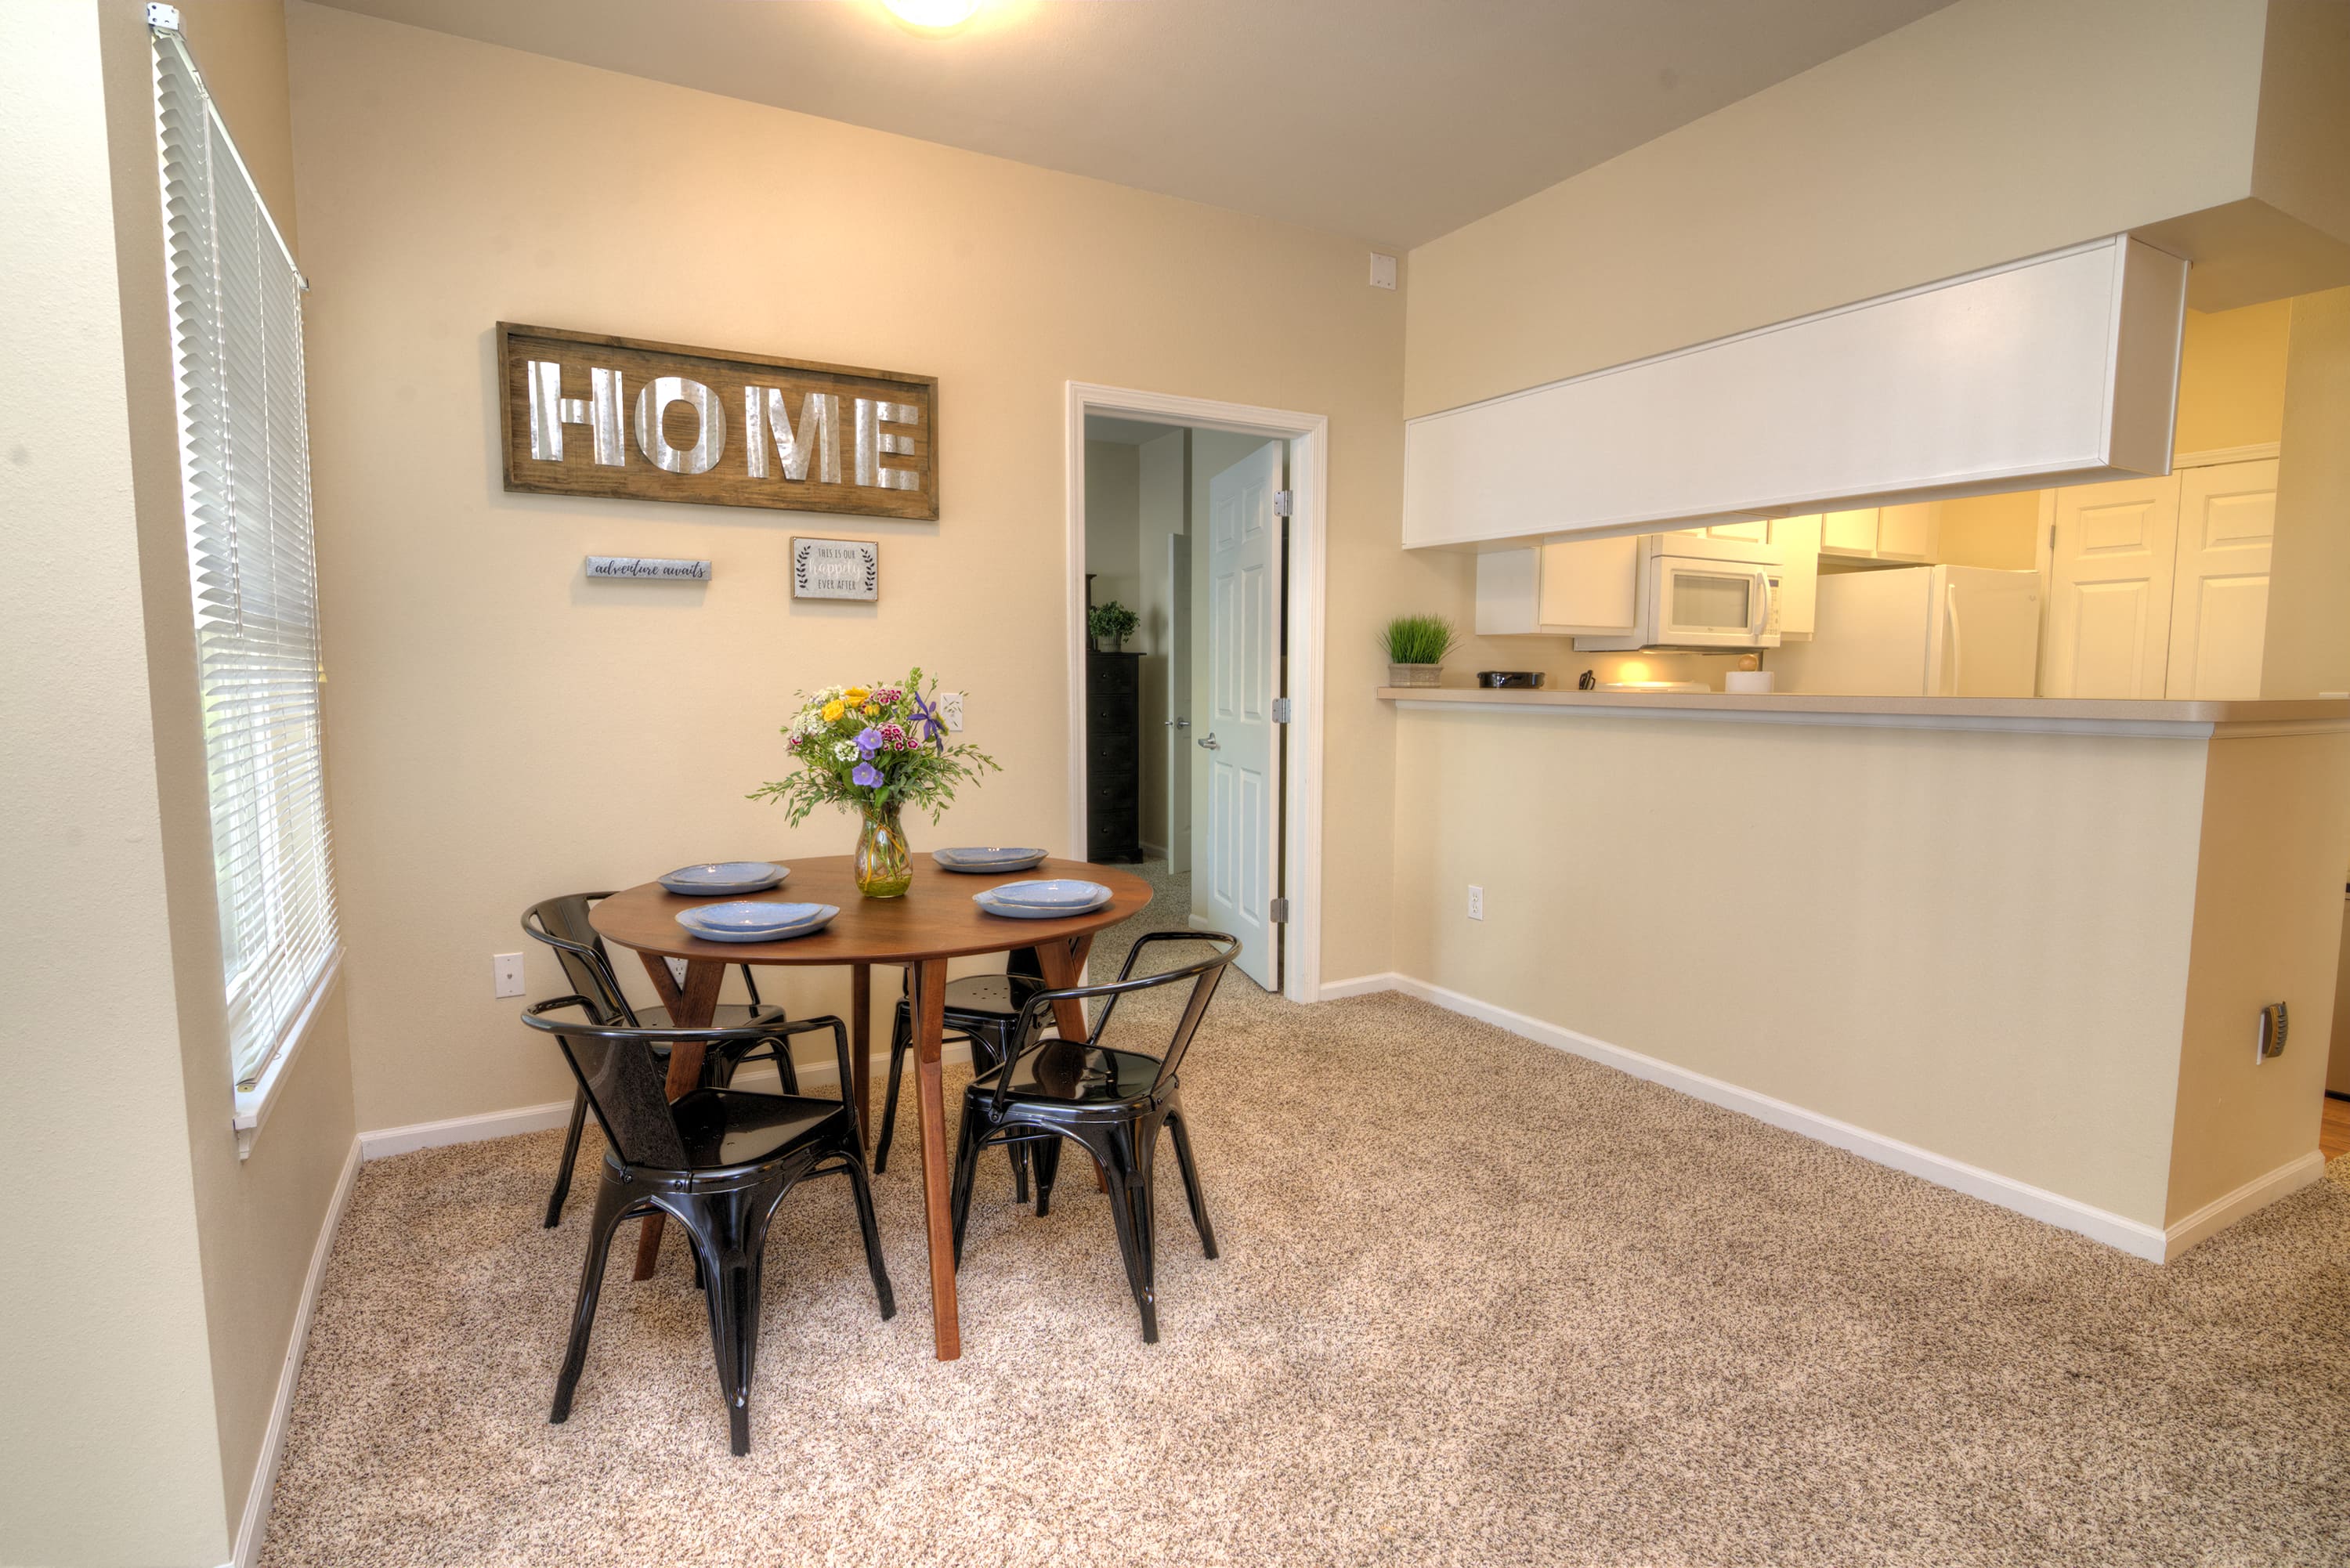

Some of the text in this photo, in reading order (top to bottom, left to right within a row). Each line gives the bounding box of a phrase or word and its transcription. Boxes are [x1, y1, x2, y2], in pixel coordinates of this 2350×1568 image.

[527, 359, 920, 491] HOME
[818, 547, 855, 559] THIS IS OUR
[595, 559, 706, 578] adventure awaits
[808, 557, 861, 582] happily
[818, 579, 856, 591] EVER AFTER
